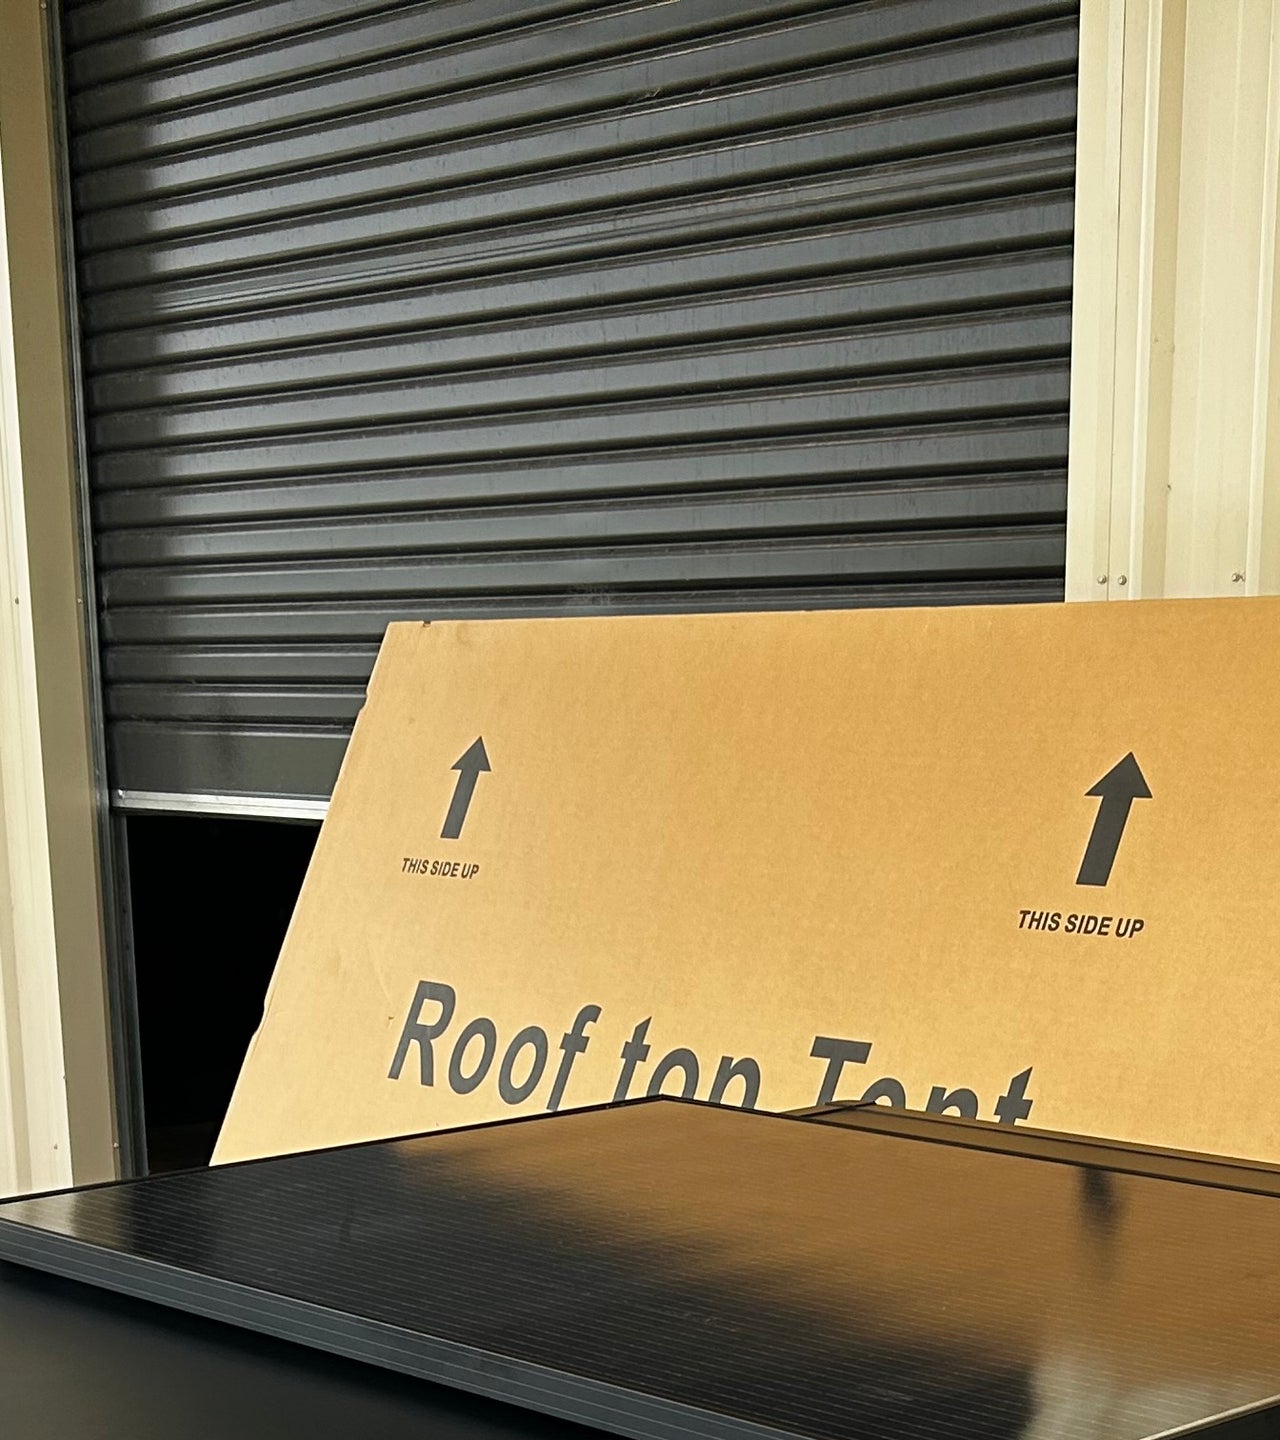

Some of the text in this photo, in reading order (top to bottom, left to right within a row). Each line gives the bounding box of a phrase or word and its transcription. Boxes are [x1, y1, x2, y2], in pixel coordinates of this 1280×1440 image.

[402, 857, 480, 880] THIS SIDE UP
[1018, 909, 1145, 939] THIS SIDE UP
[387, 979, 602, 1113] Roof
